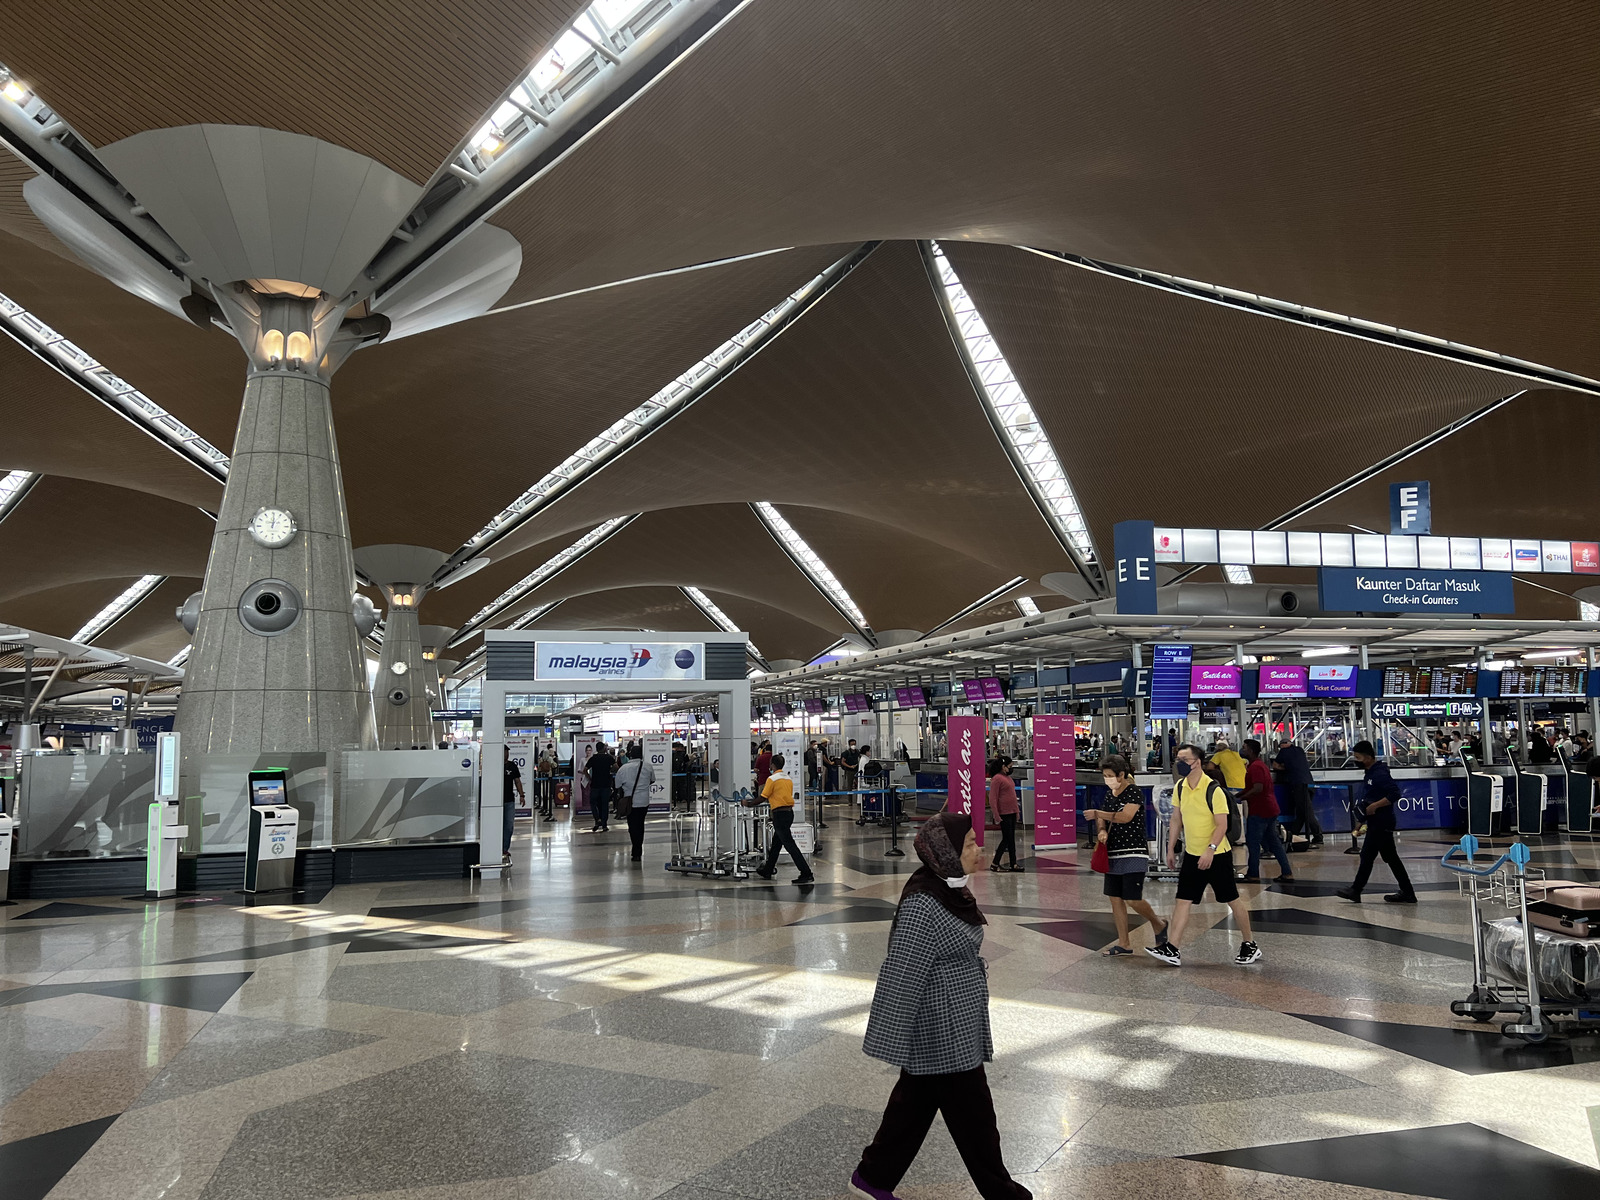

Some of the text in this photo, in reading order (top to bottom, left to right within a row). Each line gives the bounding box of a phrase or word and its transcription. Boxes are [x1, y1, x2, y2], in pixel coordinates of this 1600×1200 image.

[1400, 487, 1418, 507] E
[1401, 509, 1417, 529] F
[1118, 559, 1127, 582] E
[1136, 557, 1150, 580] E
[1356, 577, 1481, 592] Kaunter Daftar Masuk
[1383, 593, 1458, 605] Check-in Counters
[549, 655, 627, 672] malaysia
[1202, 671, 1221, 679] Batik
[1270, 671, 1288, 679] Batik
[1135, 670, 1148, 695] E
[112, 697, 122, 706] D
[1385, 705, 1391, 713] A
[1400, 705, 1405, 713] E
[1452, 705, 1457, 713] F
[512, 758, 525, 767] 60
[651, 755, 664, 763] 60
[957, 728, 972, 815] atik air
